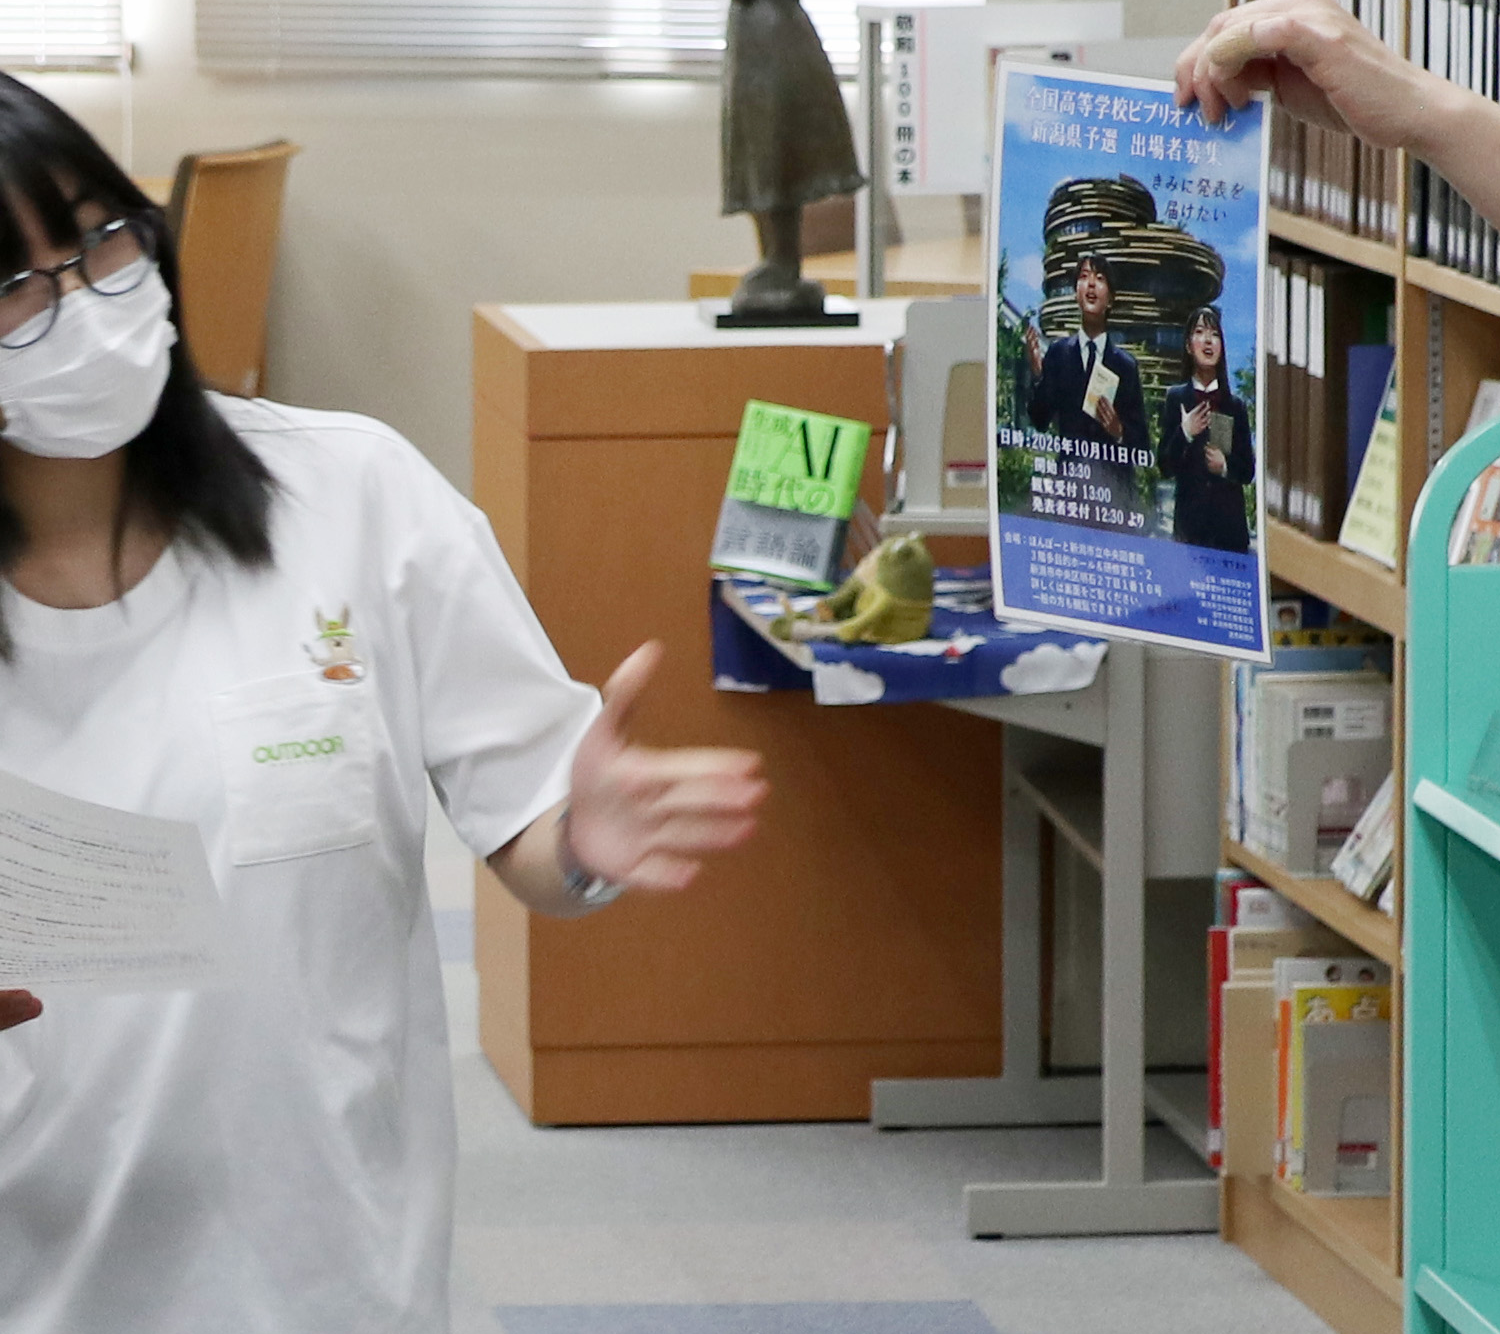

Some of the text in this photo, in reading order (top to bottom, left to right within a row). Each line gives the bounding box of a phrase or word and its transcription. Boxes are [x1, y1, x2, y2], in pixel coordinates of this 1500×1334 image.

[1031, 118, 1223, 167] 新潟県予選 出場者募集
[1151, 172, 1245, 201] きみに発表を
[1163, 199, 1229, 224] 届けたい
[1062, 461, 1092, 480] 13:30
[1082, 483, 1112, 504] 13:00
[1095, 505, 1124, 525] 12:30
[253, 734, 345, 764] OUTDOOR
